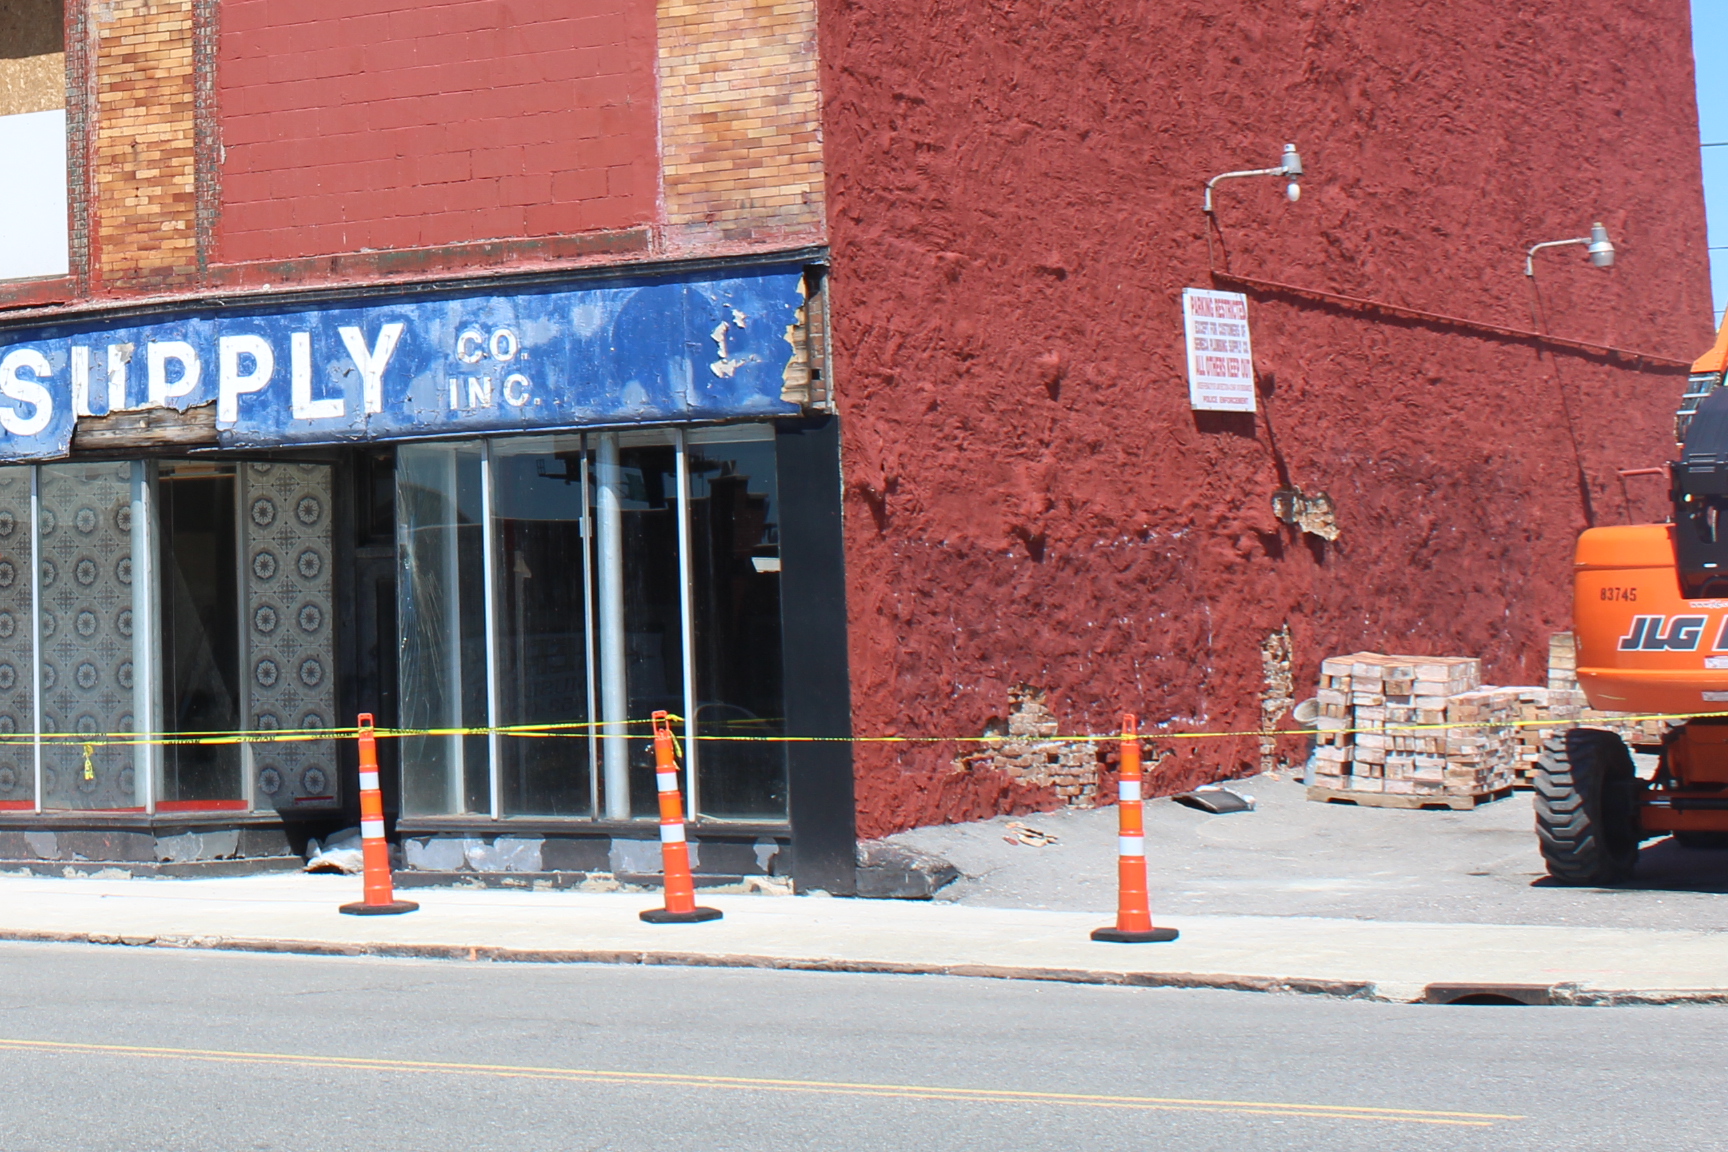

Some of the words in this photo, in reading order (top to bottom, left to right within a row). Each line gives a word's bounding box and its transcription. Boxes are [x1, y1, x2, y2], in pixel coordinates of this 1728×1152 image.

[456, 328, 529, 364] CO.
[449, 373, 542, 410] INC.
[1600, 587, 1637, 602] 83745
[1617, 615, 1709, 651] JLG
